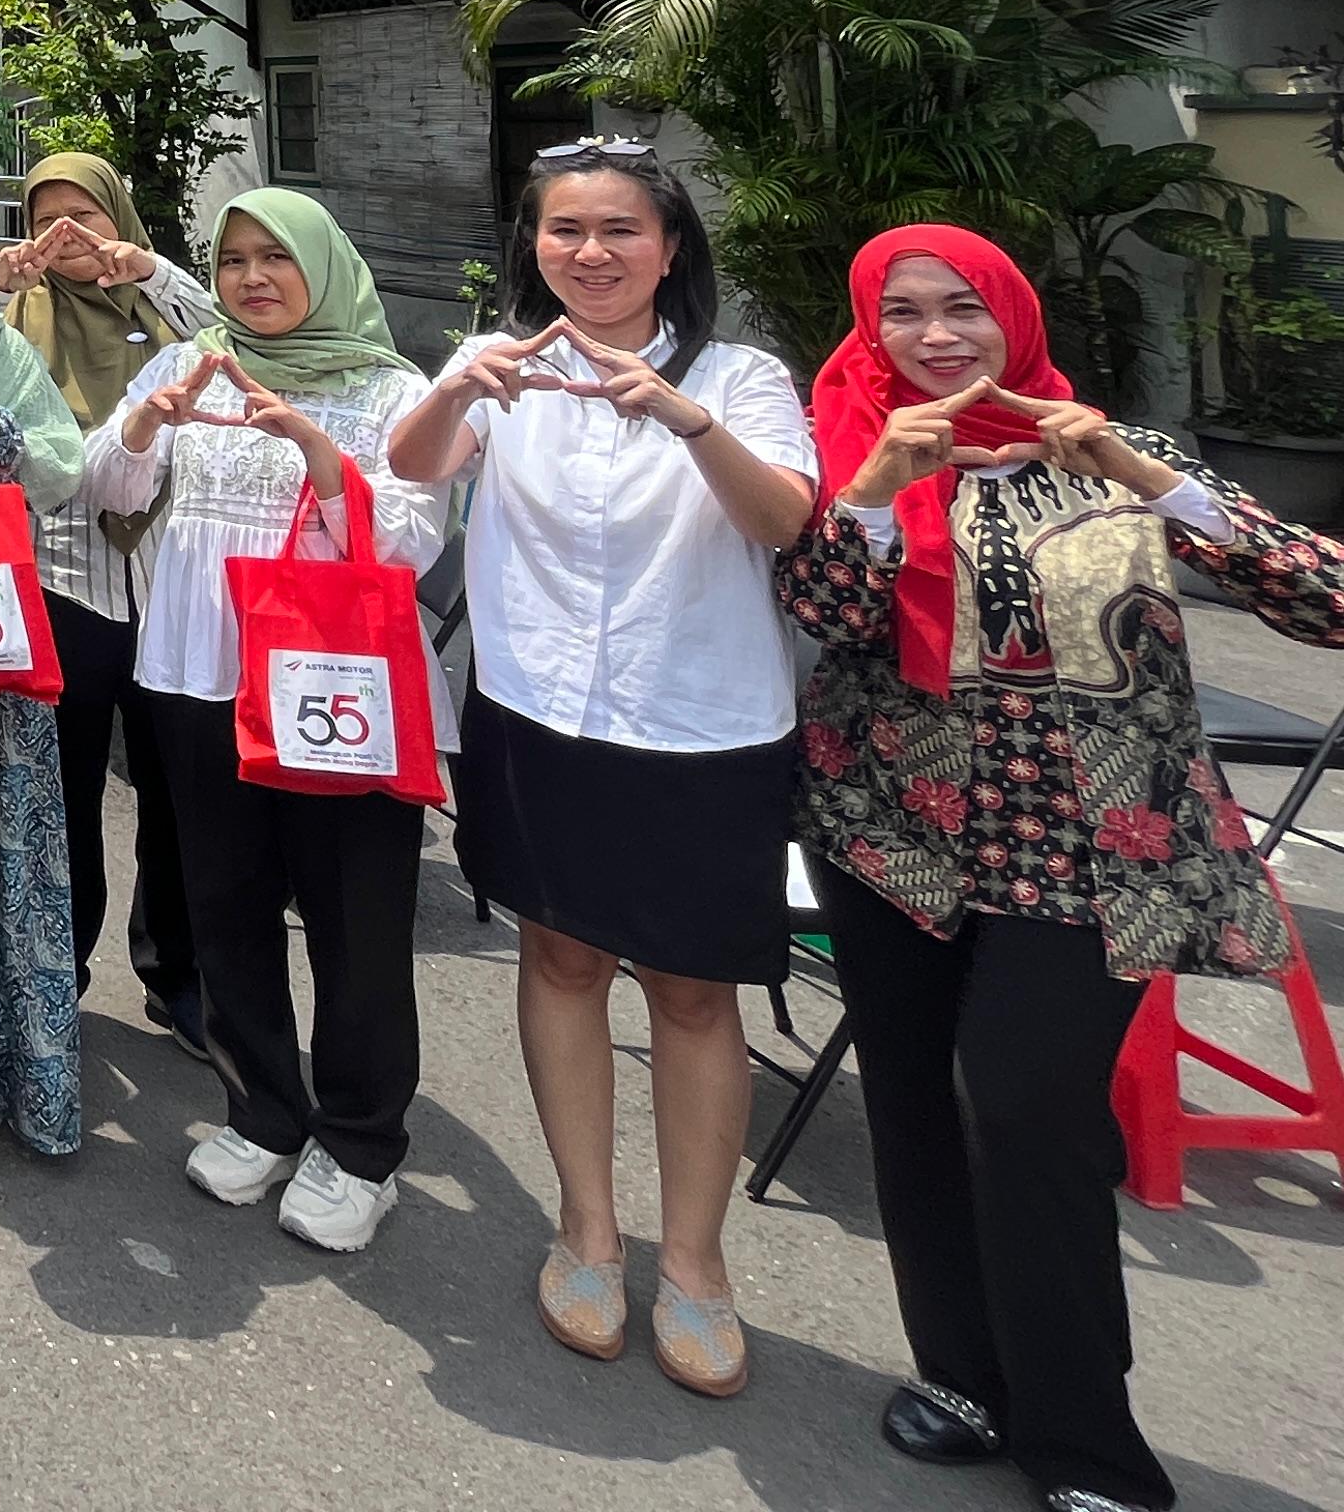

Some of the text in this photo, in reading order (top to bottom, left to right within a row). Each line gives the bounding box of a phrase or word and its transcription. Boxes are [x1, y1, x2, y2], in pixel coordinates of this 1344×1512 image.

[305, 663, 373, 674] ASTRA MOTOR
[297, 694, 370, 746] 55
